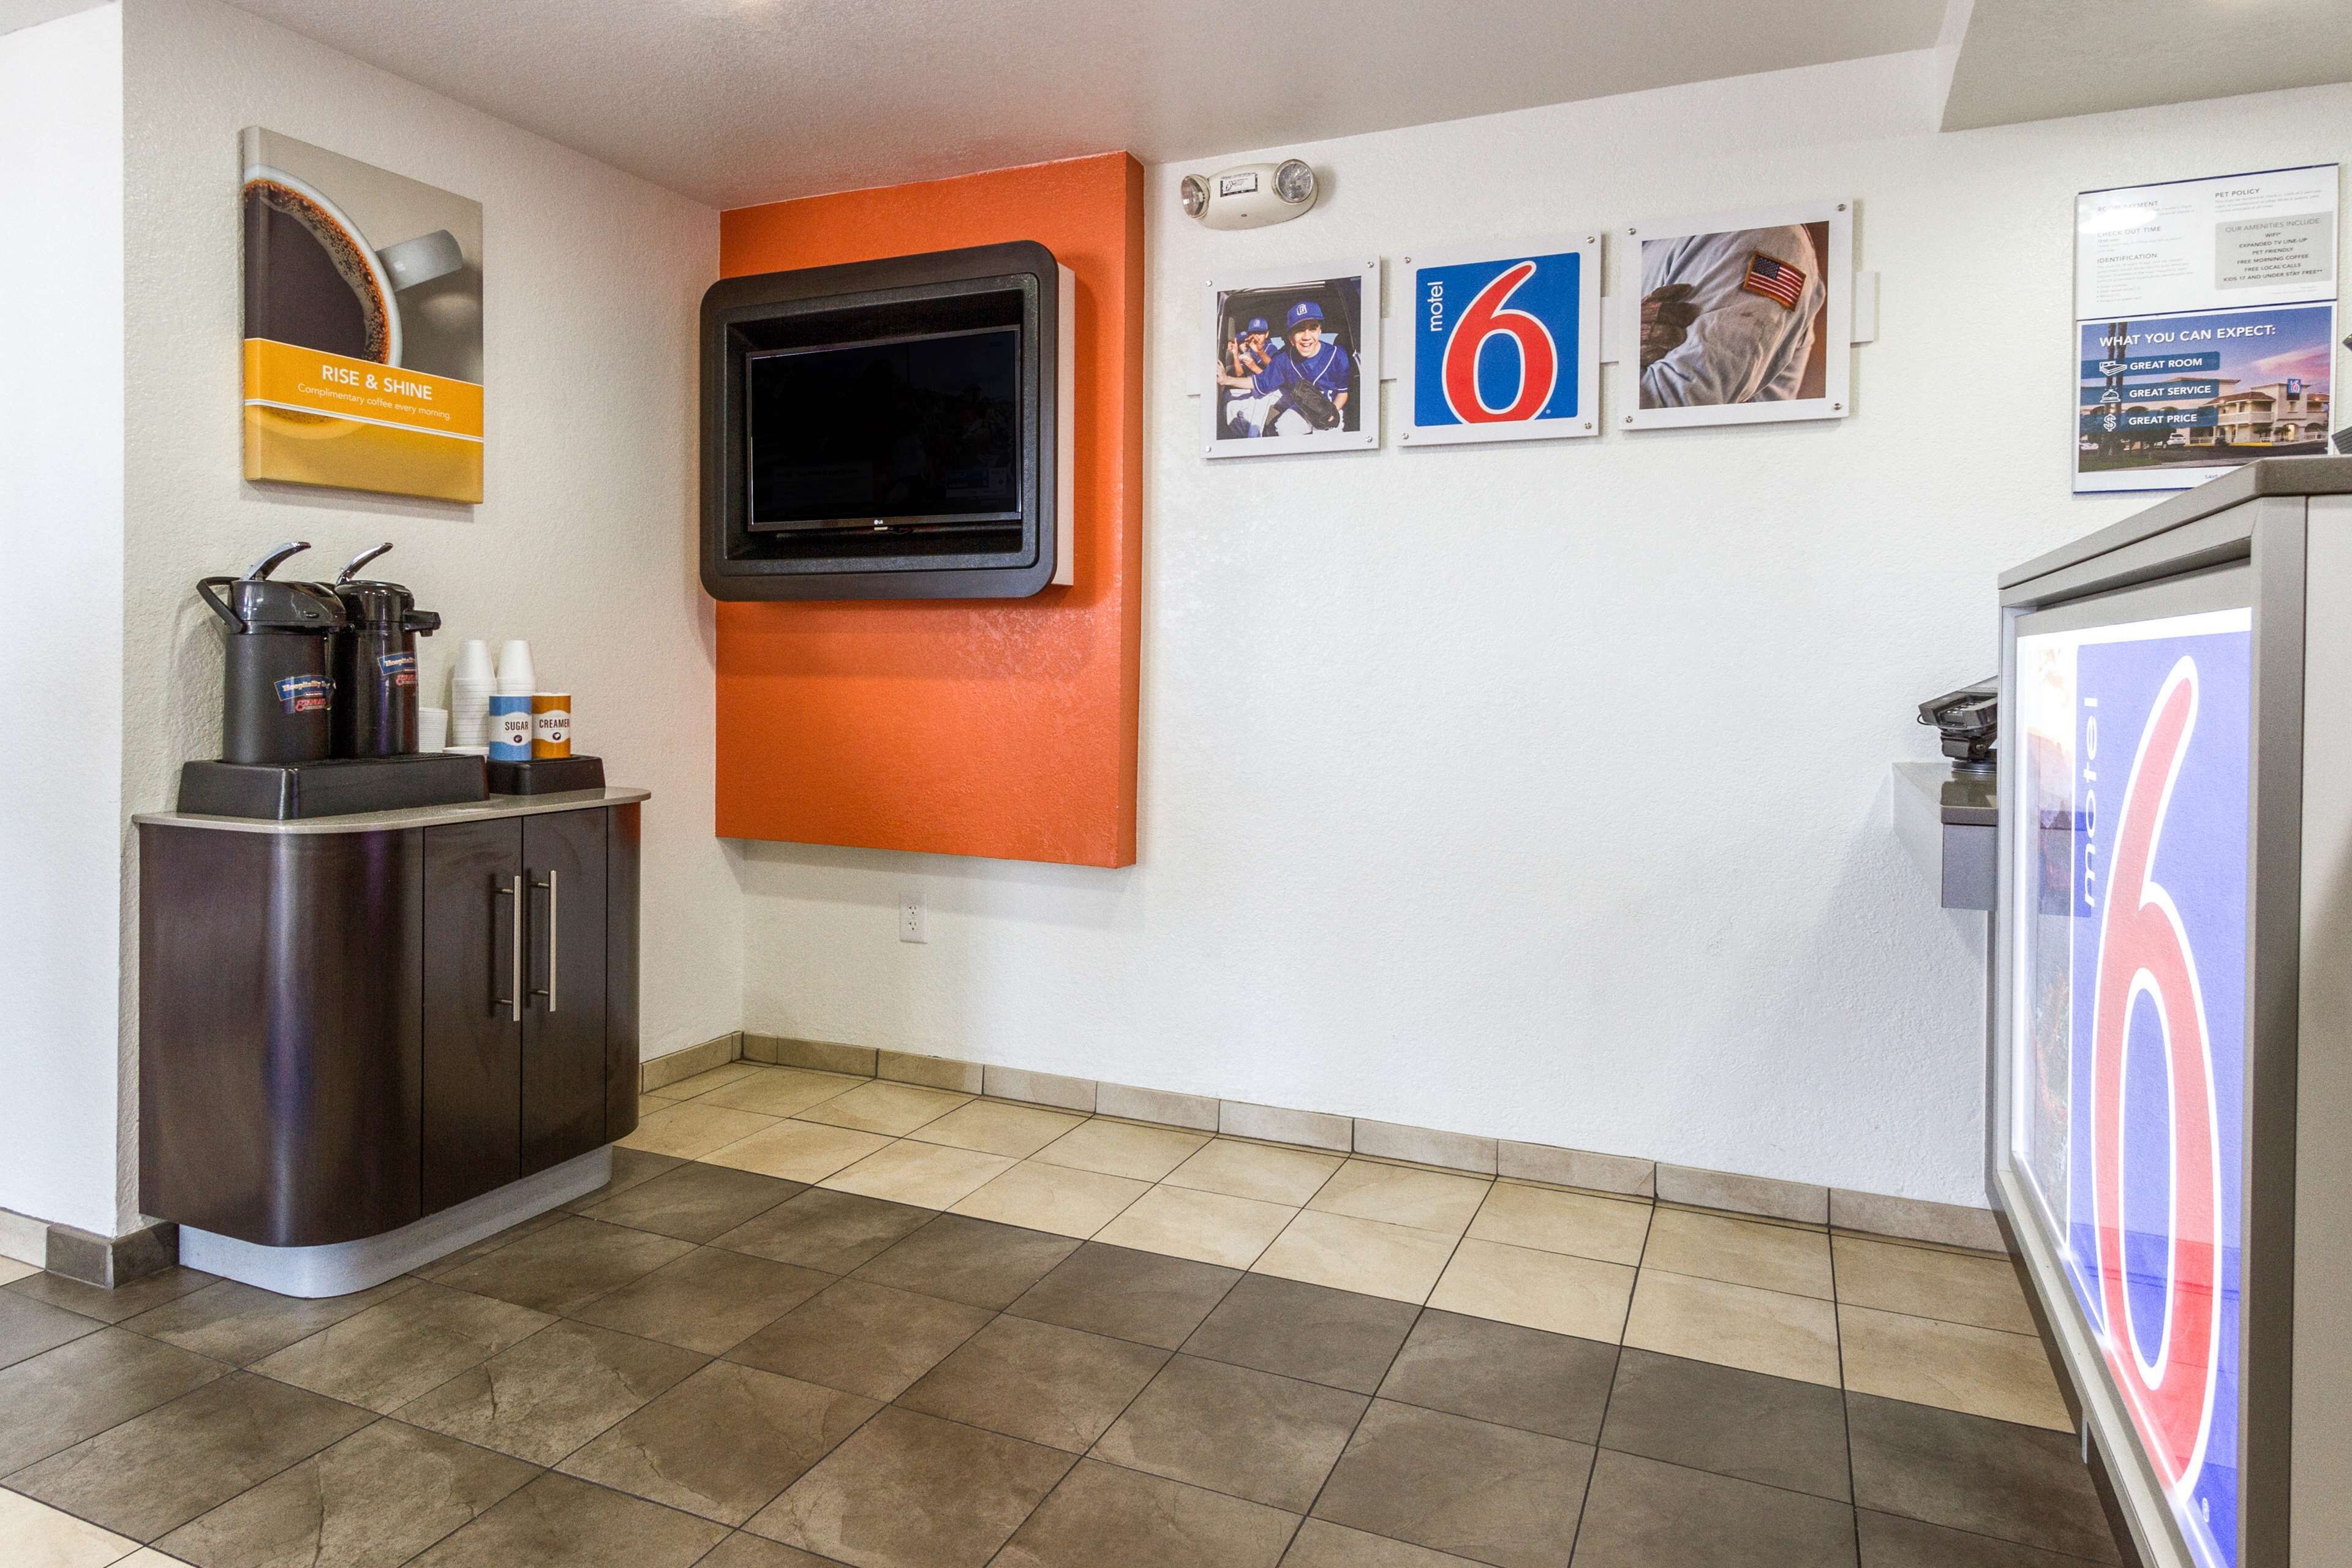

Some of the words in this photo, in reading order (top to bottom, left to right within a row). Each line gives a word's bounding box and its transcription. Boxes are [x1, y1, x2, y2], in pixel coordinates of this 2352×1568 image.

[2231, 188, 2260, 197] POLICY
[2244, 221, 2284, 231] AMENITIES
[2097, 252, 2158, 264] IDENTIFICATION
[1427, 281, 1442, 332] motel
[1442, 260, 1558, 425] 6
[2099, 334, 2140, 347] WHAT
[2146, 331, 2175, 344] YOU
[2180, 329, 2212, 342] CAN
[2217, 324, 2276, 339] EXPECT:
[2130, 360, 2165, 371] GREAT
[2168, 358, 2203, 368] ROOM
[322, 364, 360, 387] RISE
[365, 374, 378, 390] &
[383, 377, 432, 401] SHINE
[2129, 388, 2165, 398] GREAT
[2167, 384, 2212, 396] SERVICE
[298, 383, 364, 405] Complimentary
[366, 396, 393, 409] coffee
[394, 402, 416, 415] every
[418, 406, 451, 421] morning.
[2128, 416, 2164, 426] GREAT
[2166, 413, 2198, 423] PRICE
[505, 721, 529, 731] SUGAR
[539, 718, 570, 728] CREAMER
[2083, 697, 2098, 908] motel
[2091, 655, 2223, 1504] 6
